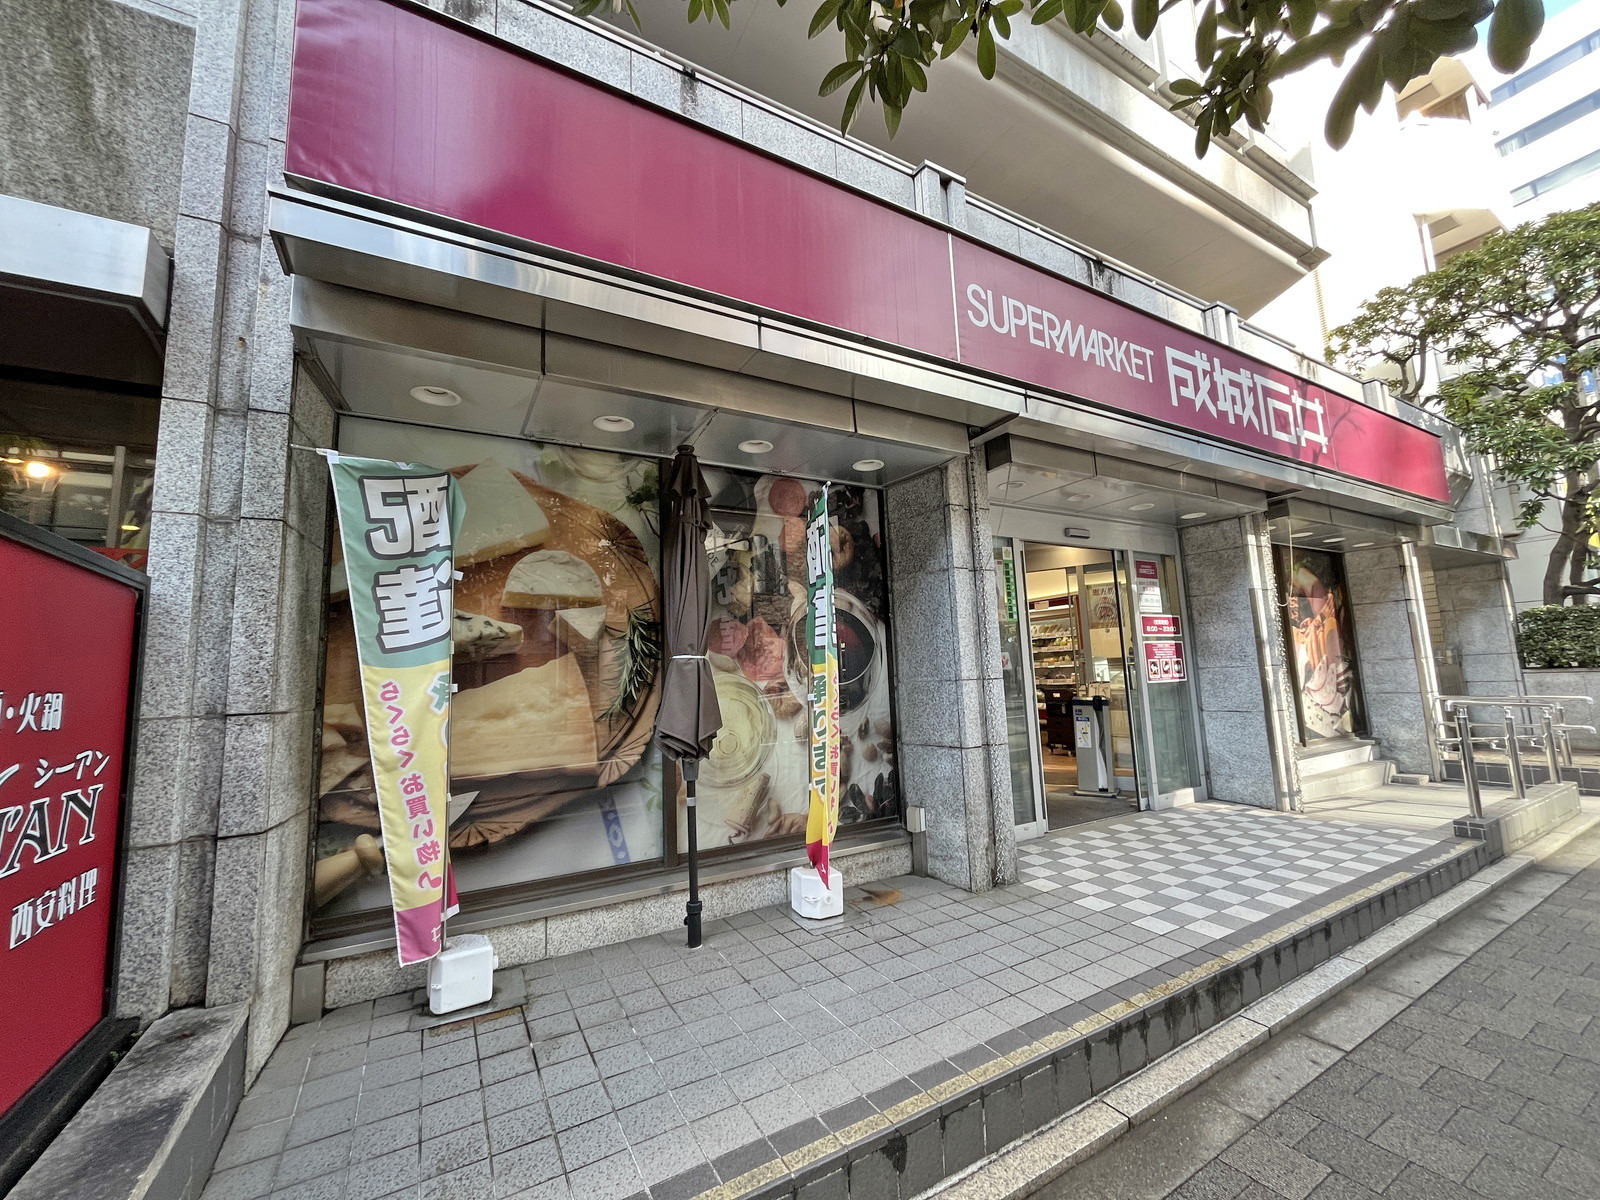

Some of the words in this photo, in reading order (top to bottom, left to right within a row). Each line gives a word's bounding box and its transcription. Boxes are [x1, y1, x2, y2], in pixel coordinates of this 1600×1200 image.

[966, 283, 1153, 383] SUPERMARKET
[1164, 344, 1329, 454] 成城石井
[0, 691, 63, 733] ・火鍋
[34, 750, 110, 788] シーアン
[9, 867, 98, 950] 西安料理
